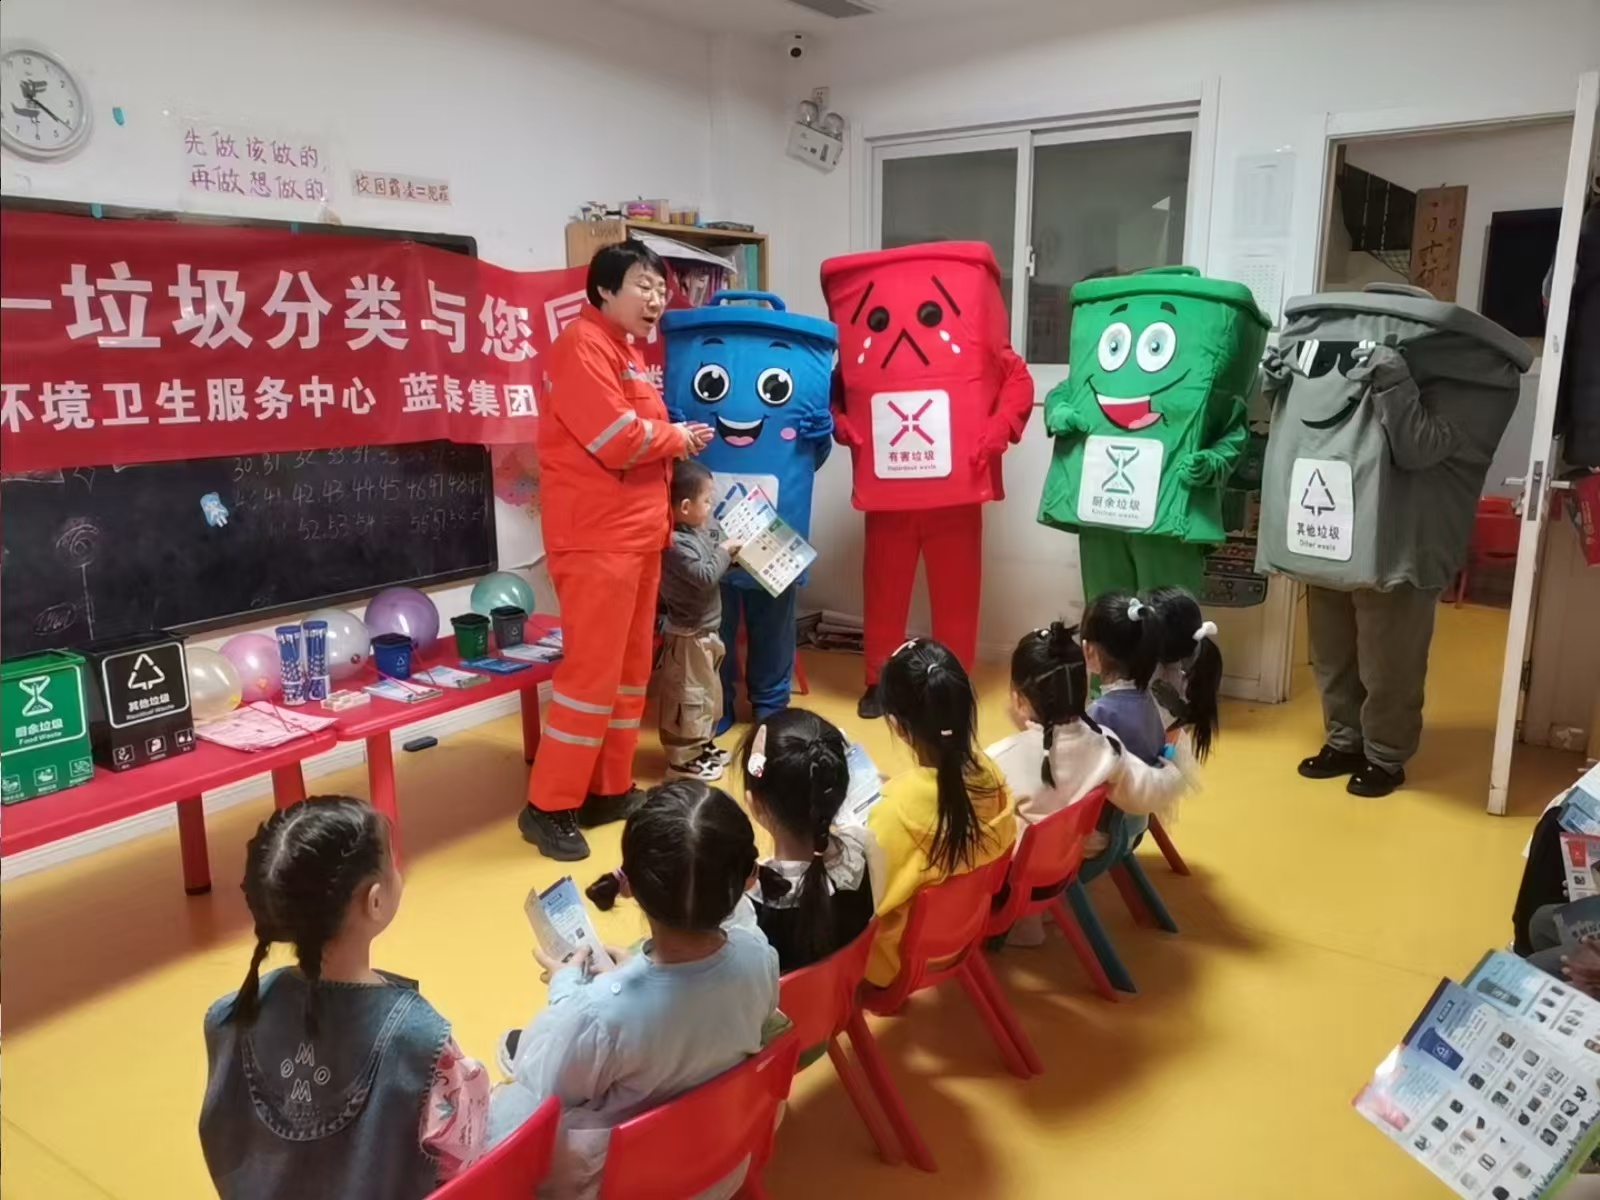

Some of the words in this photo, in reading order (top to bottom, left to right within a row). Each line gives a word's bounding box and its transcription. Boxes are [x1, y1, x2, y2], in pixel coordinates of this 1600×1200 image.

[190, 164, 325, 201] 再做想做的
[888, 450, 935, 462] 有害垃圾
[1092, 495, 1140, 511] 厨余垃圾
[1296, 522, 1339, 540] 其他垃圾
[128, 693, 170, 713] 其他垃圾
[15, 718, 64, 738] 厨余垃圾
[18, 736, 38, 745] Food
